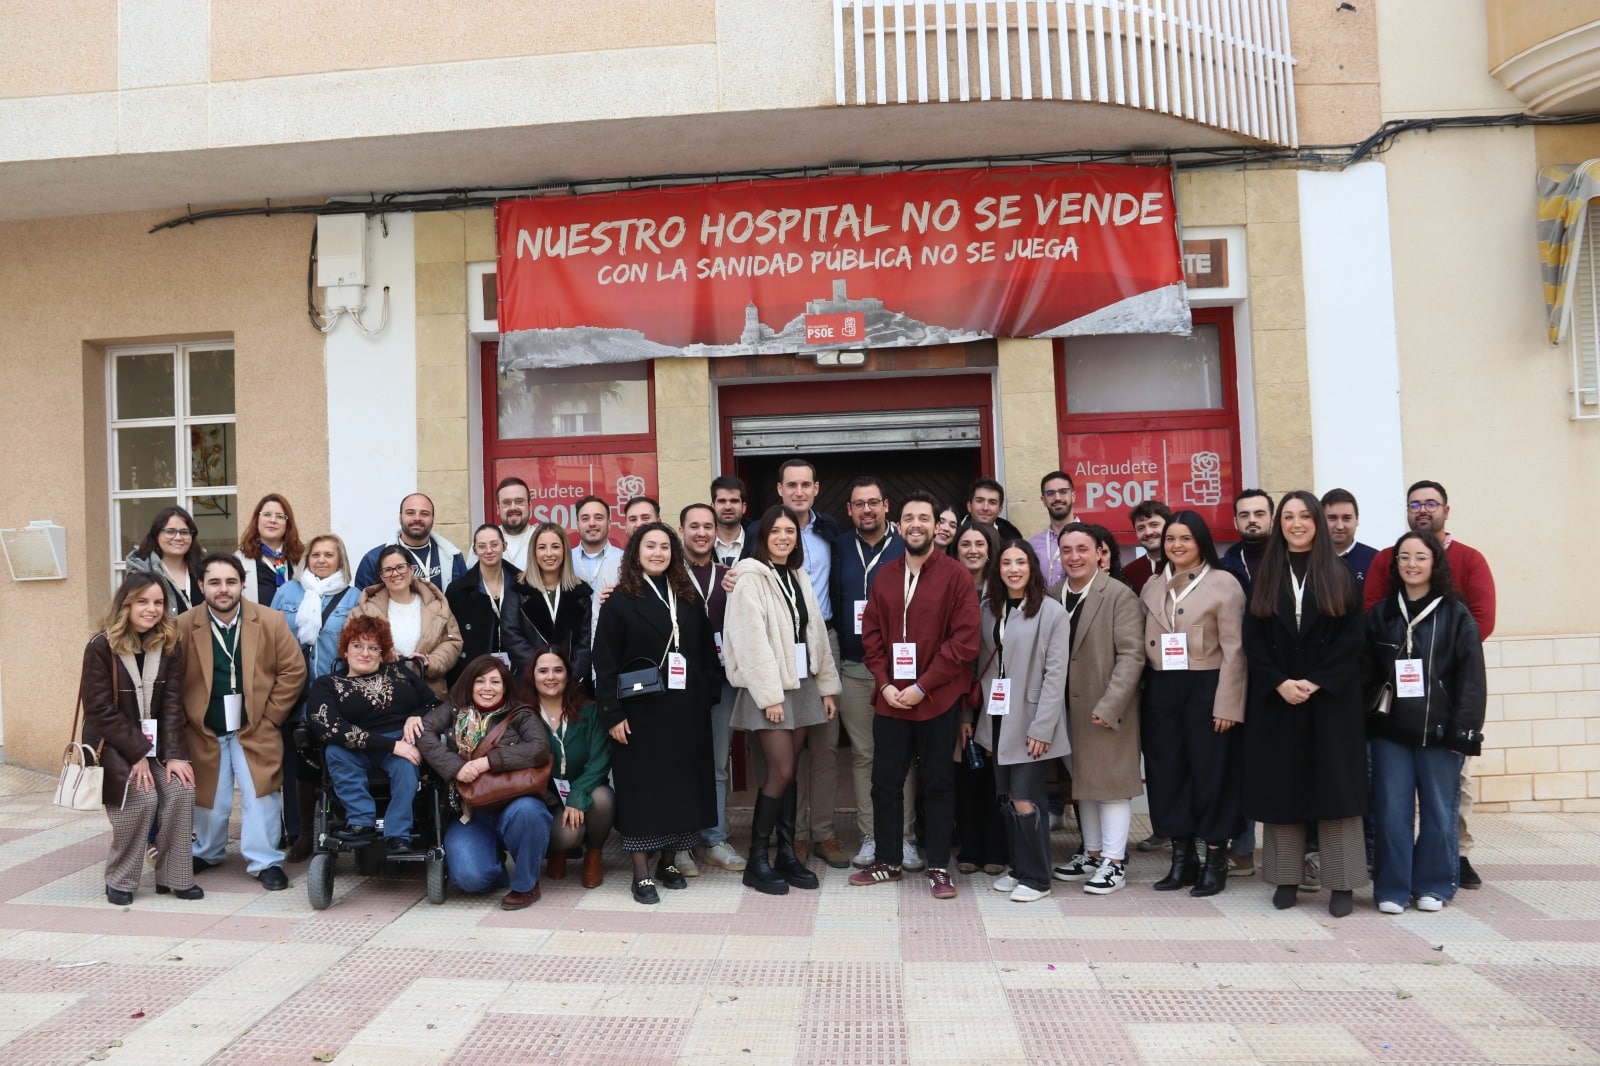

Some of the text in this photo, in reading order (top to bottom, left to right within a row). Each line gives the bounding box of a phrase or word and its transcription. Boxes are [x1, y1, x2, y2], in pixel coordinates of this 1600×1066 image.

[516, 192, 1163, 260] NUESTRO HOSPITAL NO SE VENDE
[598, 236, 1079, 285] CON LA SANIDAD PÚBLICA NO SE JUEGA
[1184, 253, 1211, 273] TE
[807, 327, 834, 339] PSOE
[1075, 459, 1158, 476] Alcaudete
[530, 483, 584, 499] audete
[530, 503, 578, 530] SO
